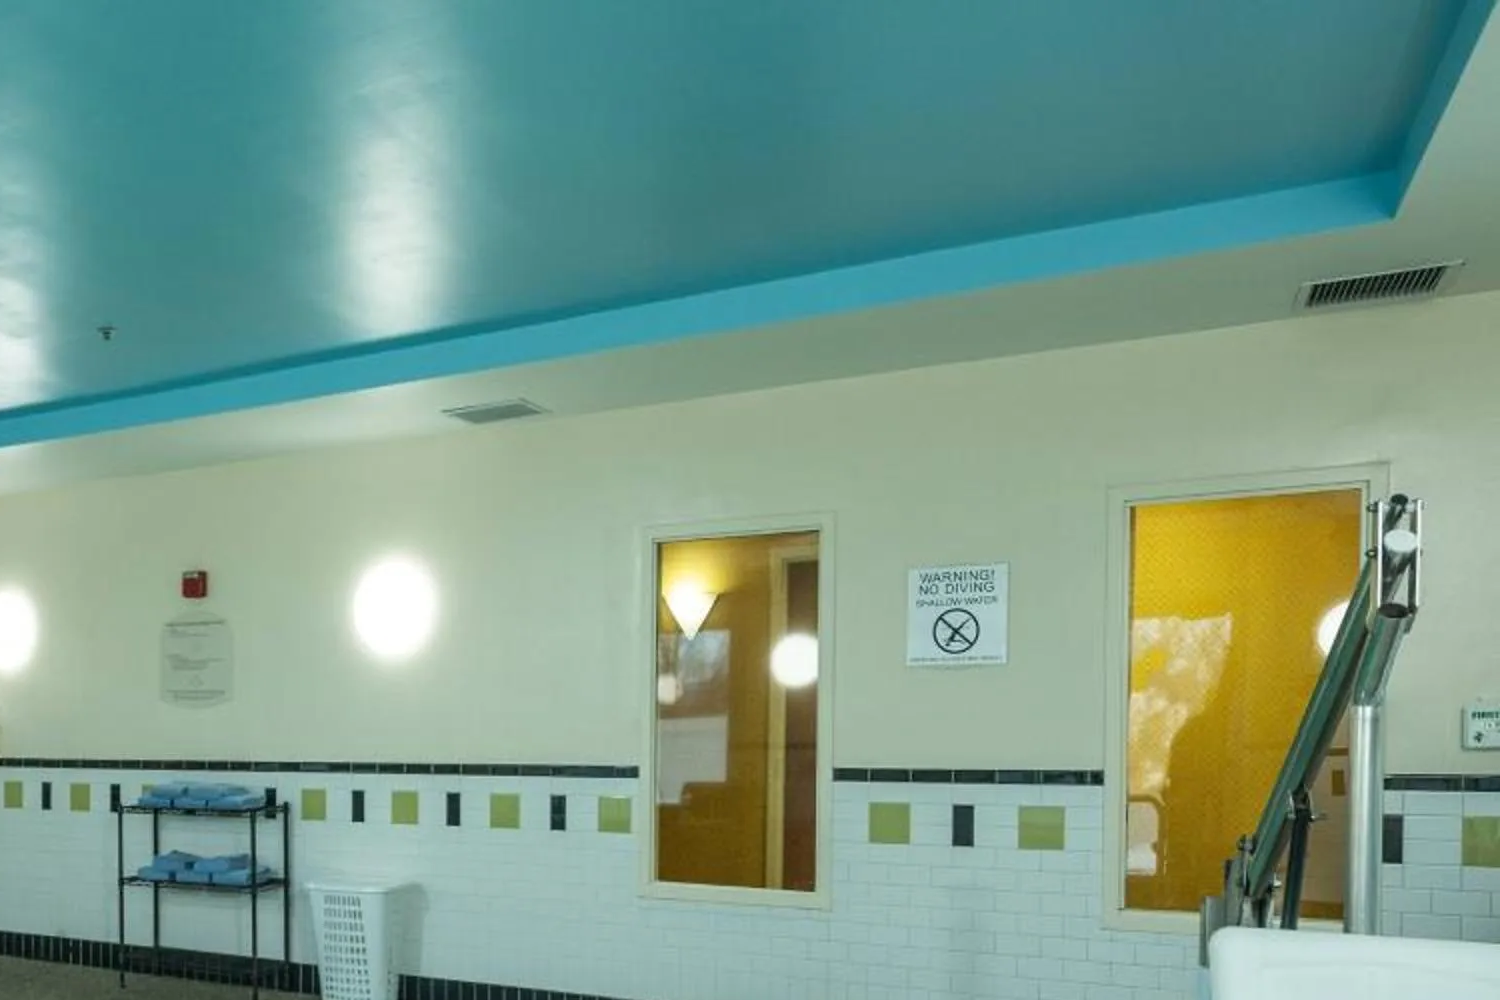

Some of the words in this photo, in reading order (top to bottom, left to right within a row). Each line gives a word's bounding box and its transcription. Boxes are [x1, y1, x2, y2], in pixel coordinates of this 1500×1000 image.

[920, 569, 995, 583] WARNING!
[919, 583, 939, 595] NO
[945, 581, 995, 594] DIVING
